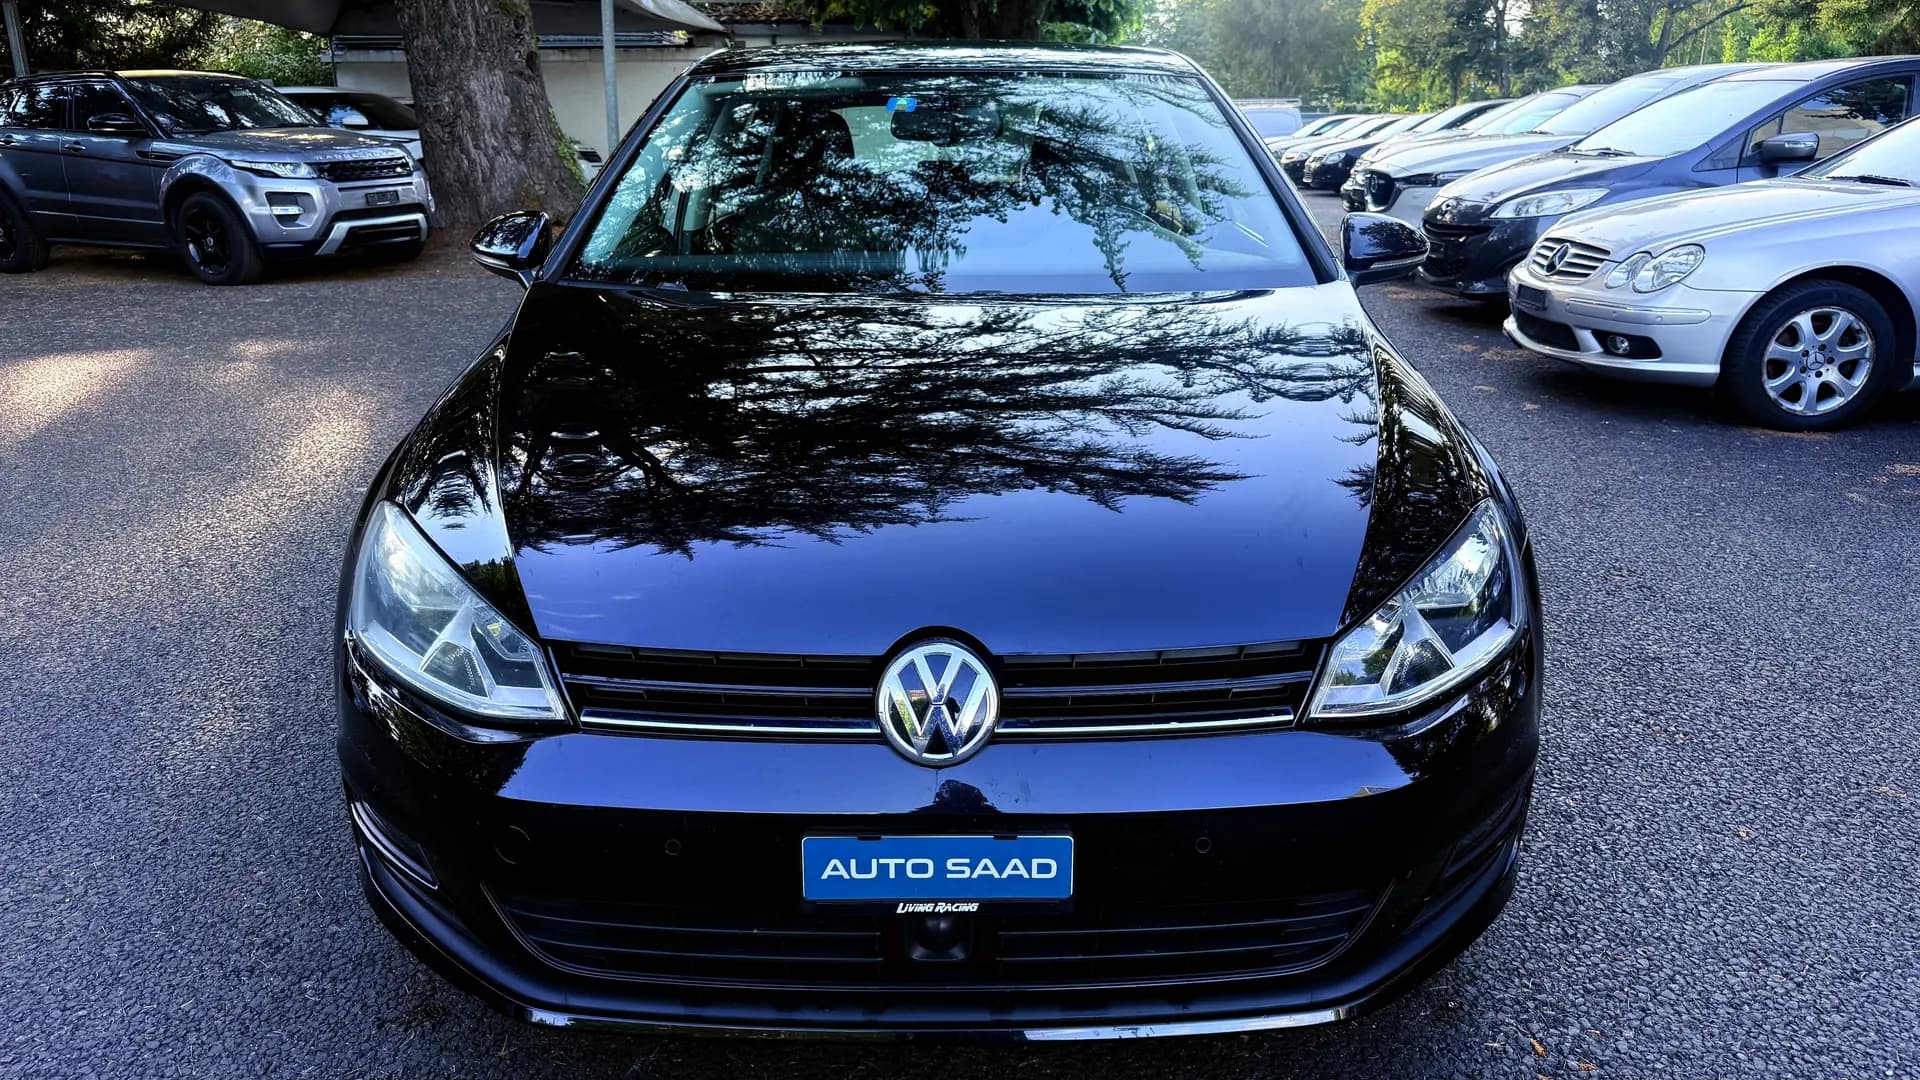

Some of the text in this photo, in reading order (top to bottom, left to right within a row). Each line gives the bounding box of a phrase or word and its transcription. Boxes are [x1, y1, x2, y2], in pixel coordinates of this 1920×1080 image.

[879, 643, 997, 761] VW
[821, 858, 1058, 879] AUTO SAAD
[934, 902, 979, 913] RACING
